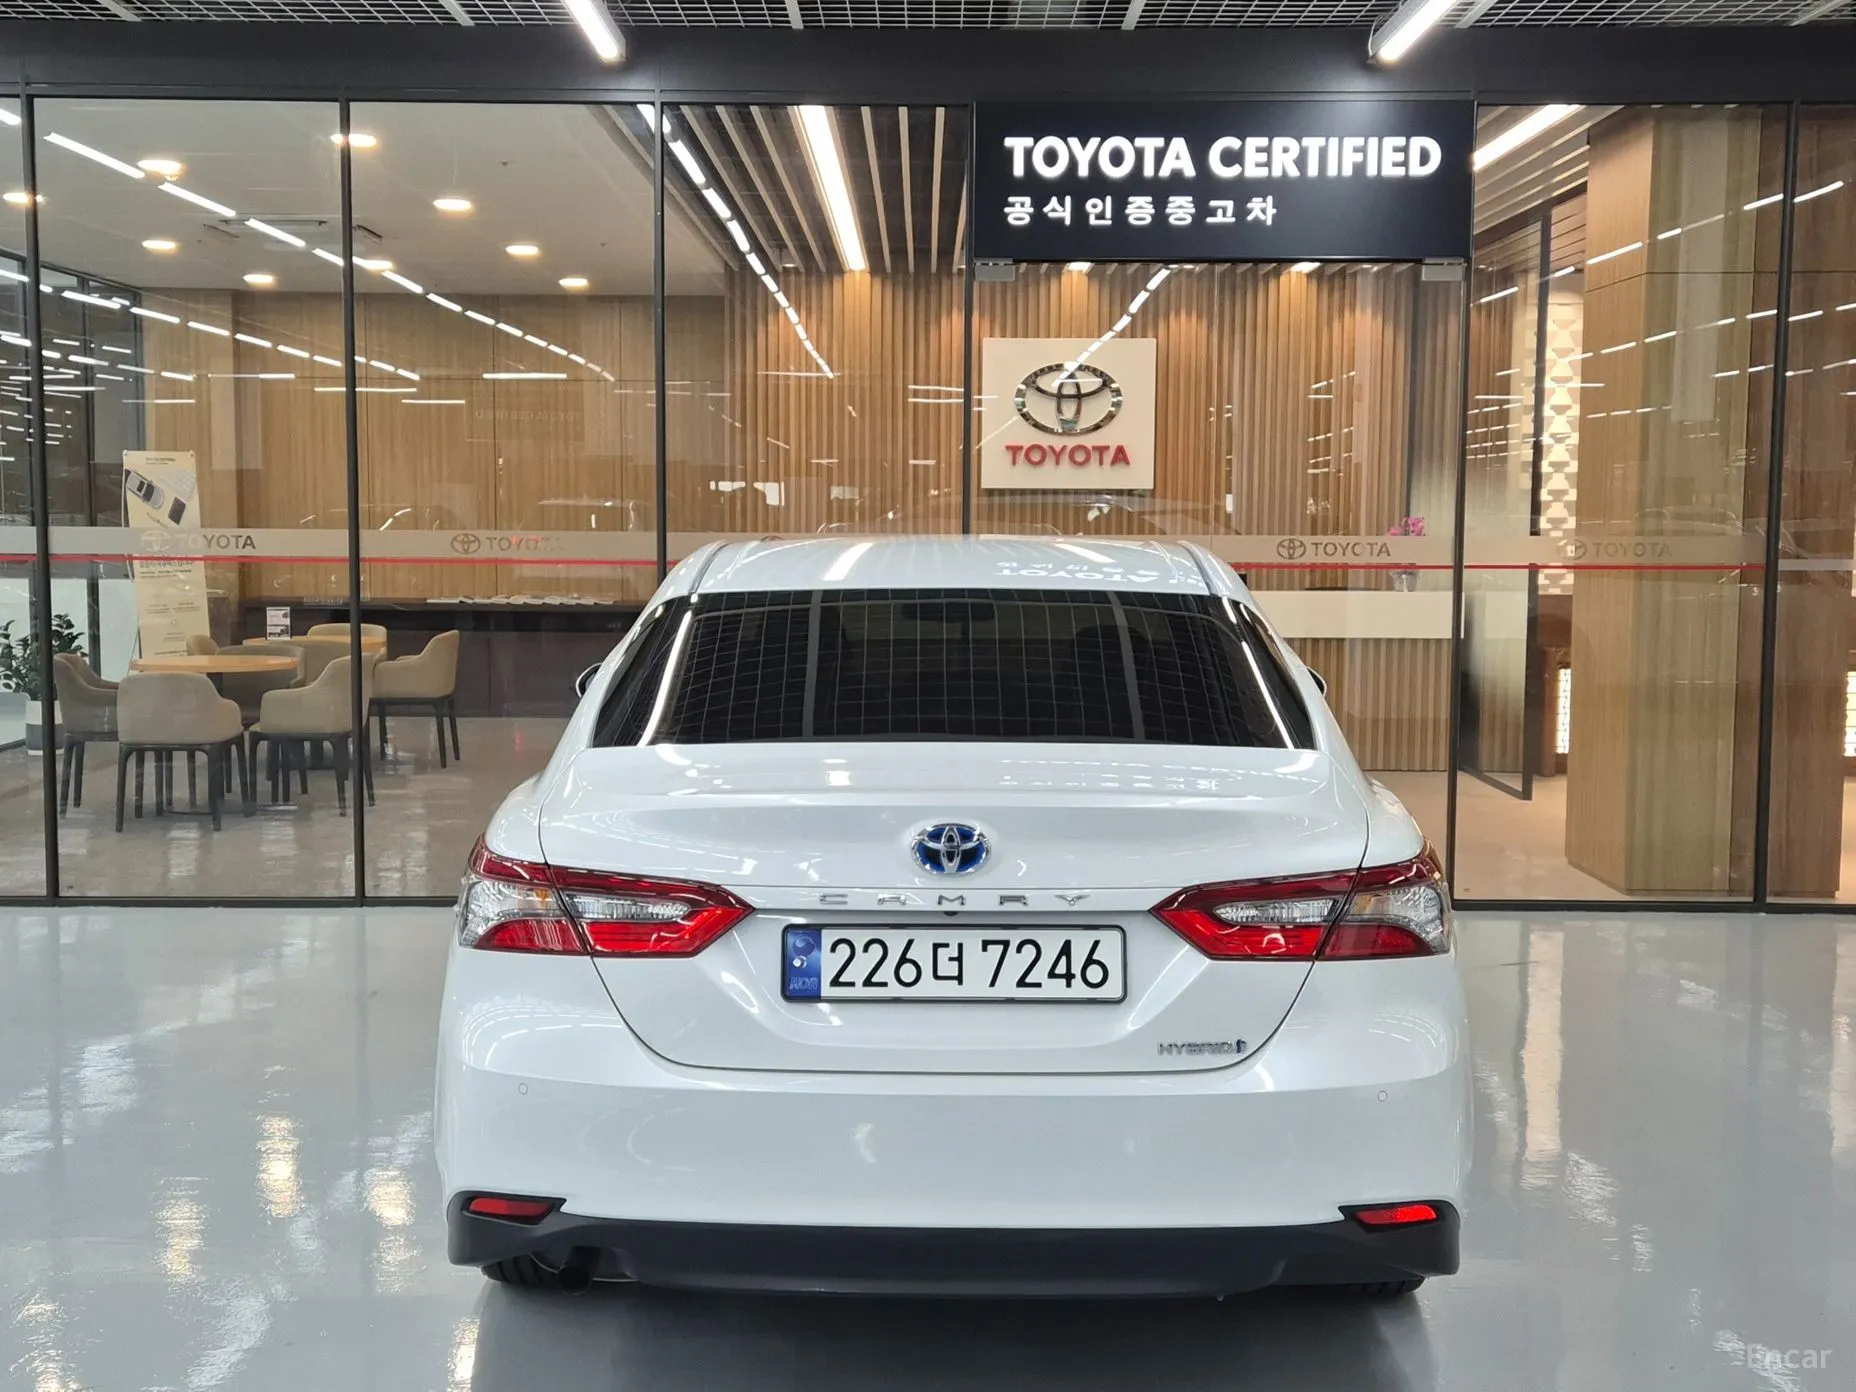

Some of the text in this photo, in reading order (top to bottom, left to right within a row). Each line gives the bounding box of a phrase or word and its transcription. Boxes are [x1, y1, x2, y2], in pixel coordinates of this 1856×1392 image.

[1004, 136, 1442, 178] TOYOTA CERTIFIED
[1005, 443, 1131, 466] TOYOTA
[1311, 542, 1391, 557] TOYOTA
[1592, 542, 1673, 557] TOYOTA
[819, 893, 1091, 907] CAMRY
[981, 938, 1110, 988] 7246
[789, 976, 819, 990] KOR
[1158, 1042, 1233, 1056] HYBRID
